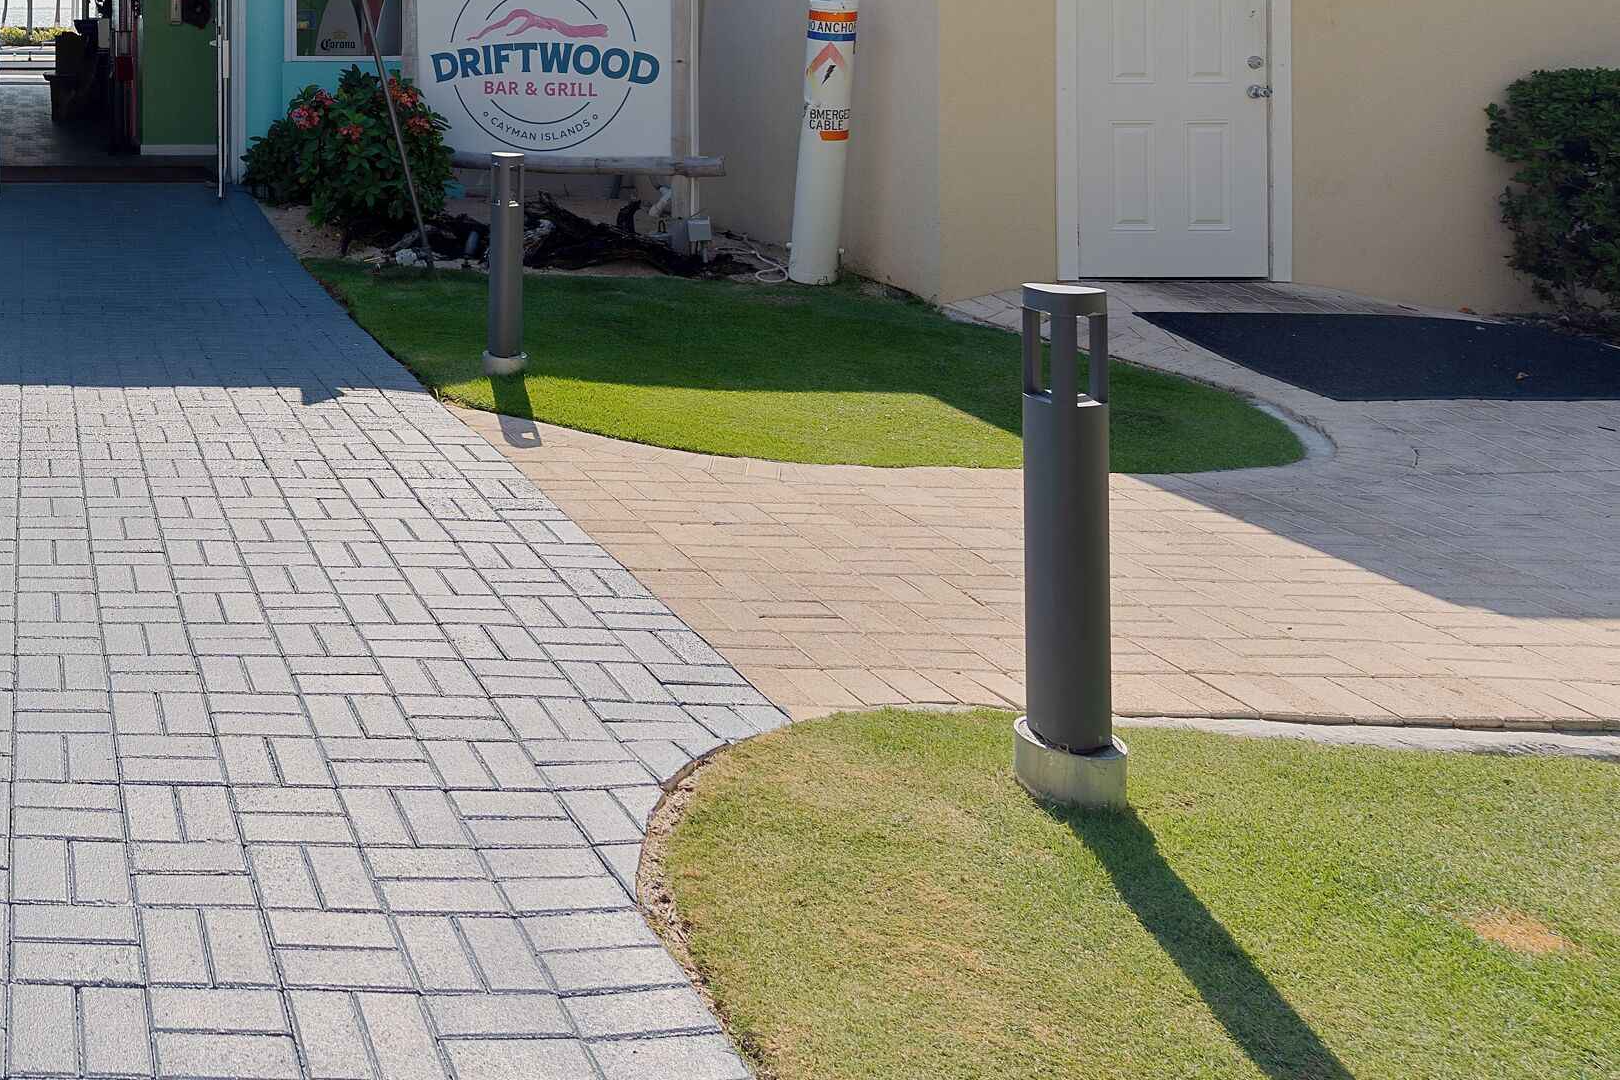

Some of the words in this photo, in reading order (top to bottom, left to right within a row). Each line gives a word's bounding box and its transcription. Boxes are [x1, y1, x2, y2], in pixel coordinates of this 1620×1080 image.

[320, 38, 356, 51] Corona
[430, 42, 660, 85] DRIFTWOOD
[484, 80, 519, 96] BAR
[524, 81, 538, 96] &
[544, 81, 598, 97] GRILL
[490, 116, 537, 141] CAYMAN
[540, 119, 591, 141] ISLANDS
[809, 119, 844, 130] CABLE
